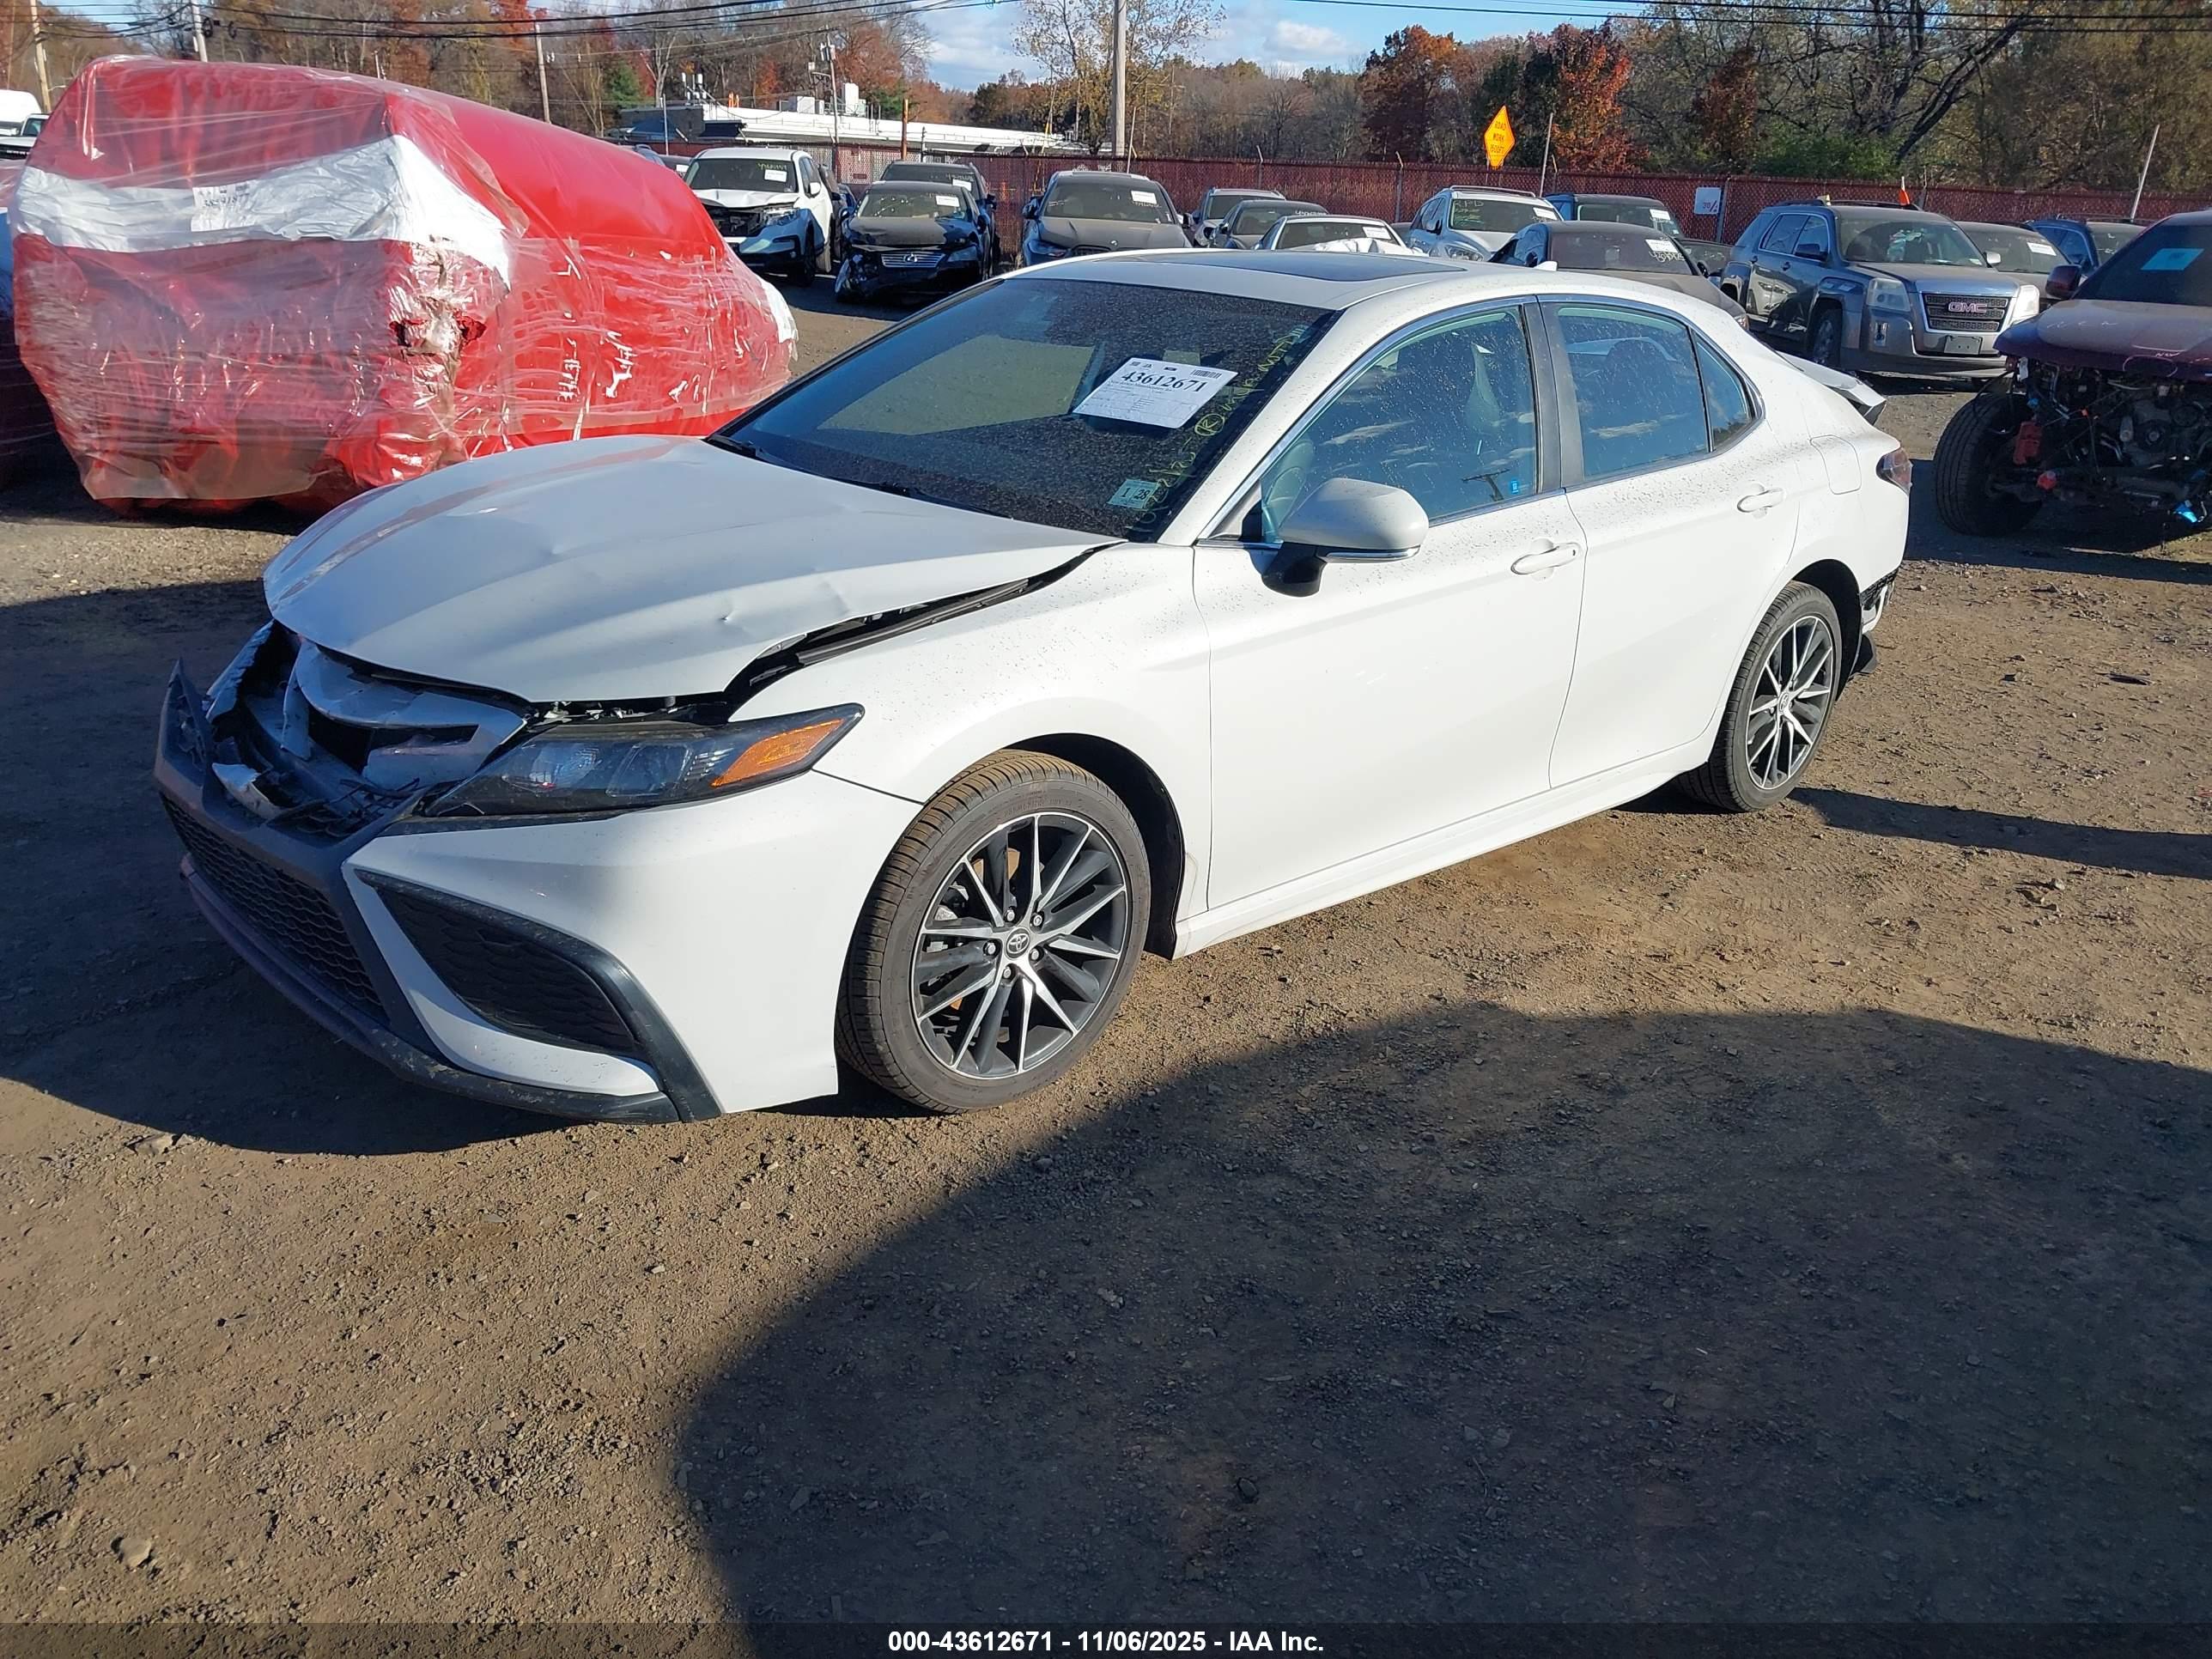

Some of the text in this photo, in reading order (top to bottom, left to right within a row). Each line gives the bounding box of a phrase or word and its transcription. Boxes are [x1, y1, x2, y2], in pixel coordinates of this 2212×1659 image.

[1948, 301, 1988, 313] GMC
[1121, 371, 1207, 392] 43612671
[1133, 489, 1151, 500] 28
